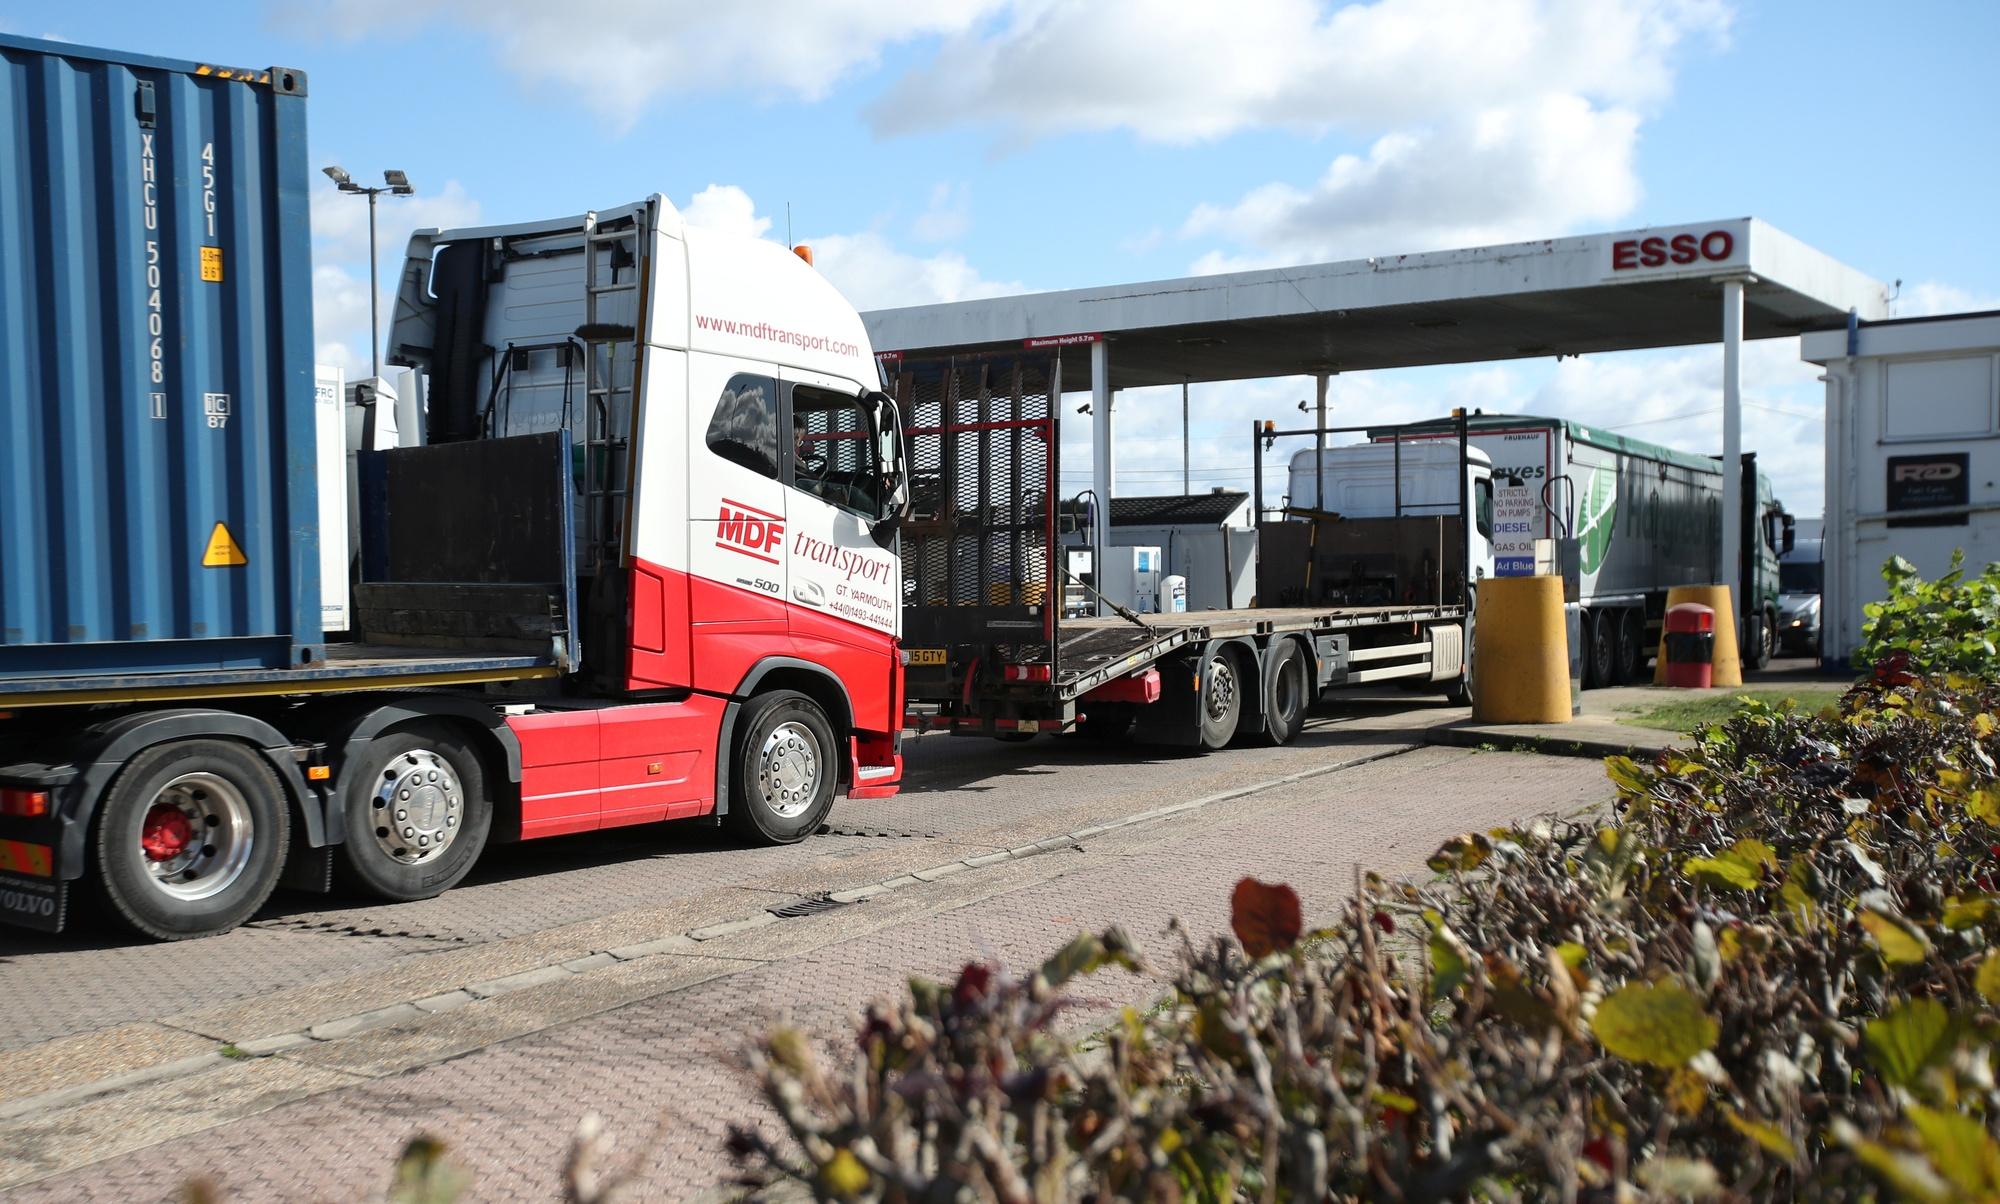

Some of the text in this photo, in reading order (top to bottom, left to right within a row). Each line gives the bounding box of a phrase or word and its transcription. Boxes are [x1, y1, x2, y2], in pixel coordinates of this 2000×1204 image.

[142, 133, 157, 230] XHCU
[202, 142, 215, 237] 45G1
[1613, 230, 1734, 271] ESSO
[147, 240, 163, 384] 504068
[696, 314, 859, 358] www.mdftransport.com
[1494, 498, 1534, 508] NO PARKING
[1498, 488, 1529, 498] STRICTLY
[1497, 509, 1531, 518] ON PUMPS
[717, 506, 785, 553] MDF
[1494, 523, 1533, 533] DIESEL
[793, 530, 891, 585] transport
[1494, 542, 1535, 552] GAS OIL
[1496, 561, 1534, 571] Ad Blue
[754, 577, 780, 594] 500
[836, 584, 892, 612] GT. YARMOUTH
[922, 651, 943, 662] GTY
